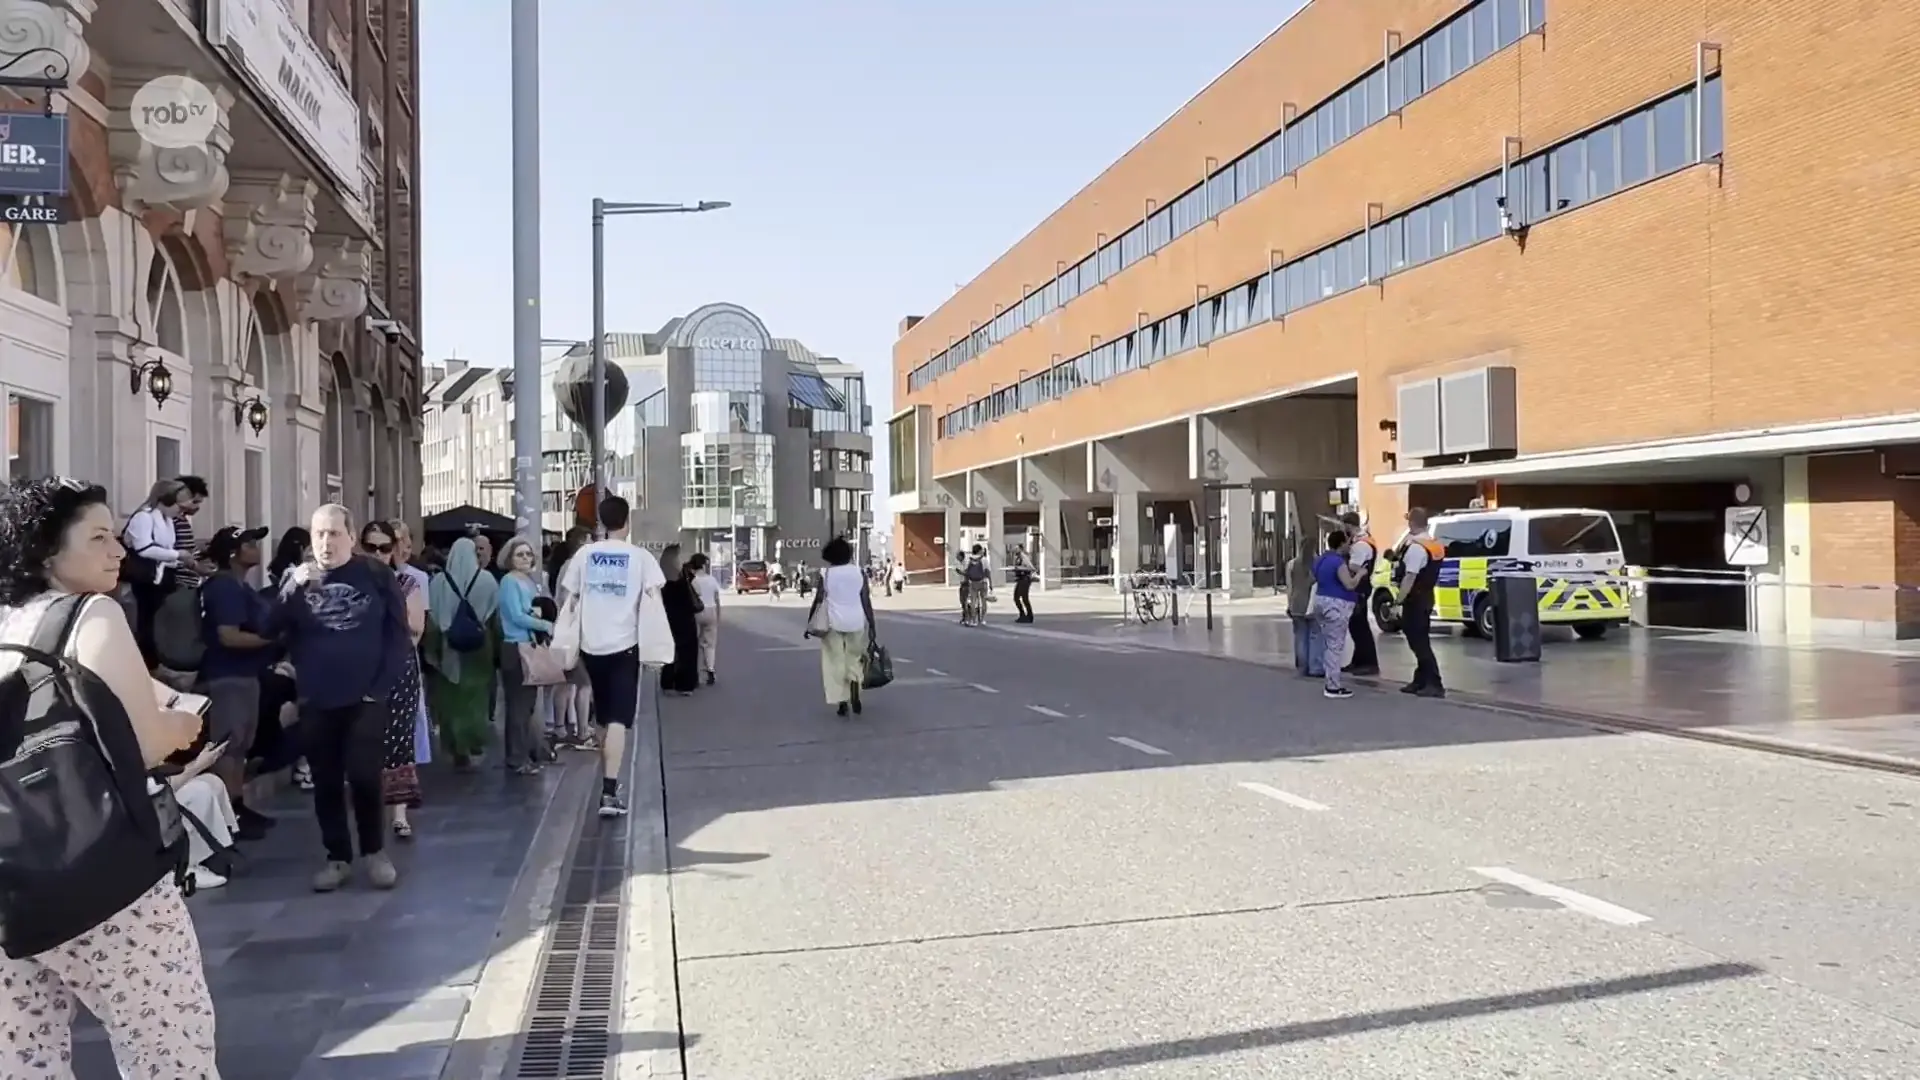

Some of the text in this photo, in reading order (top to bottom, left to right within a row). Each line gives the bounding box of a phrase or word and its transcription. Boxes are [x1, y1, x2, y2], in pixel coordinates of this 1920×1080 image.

[0, 144, 46, 165] ER.
[5, 207, 57, 221] GARE
[699, 336, 756, 350] acerta
[1207, 449, 1220, 470] 2
[1100, 468, 1113, 486] 4
[1028, 480, 1038, 495] 6
[976, 490, 984, 504] 8
[592, 553, 625, 567] VANS
